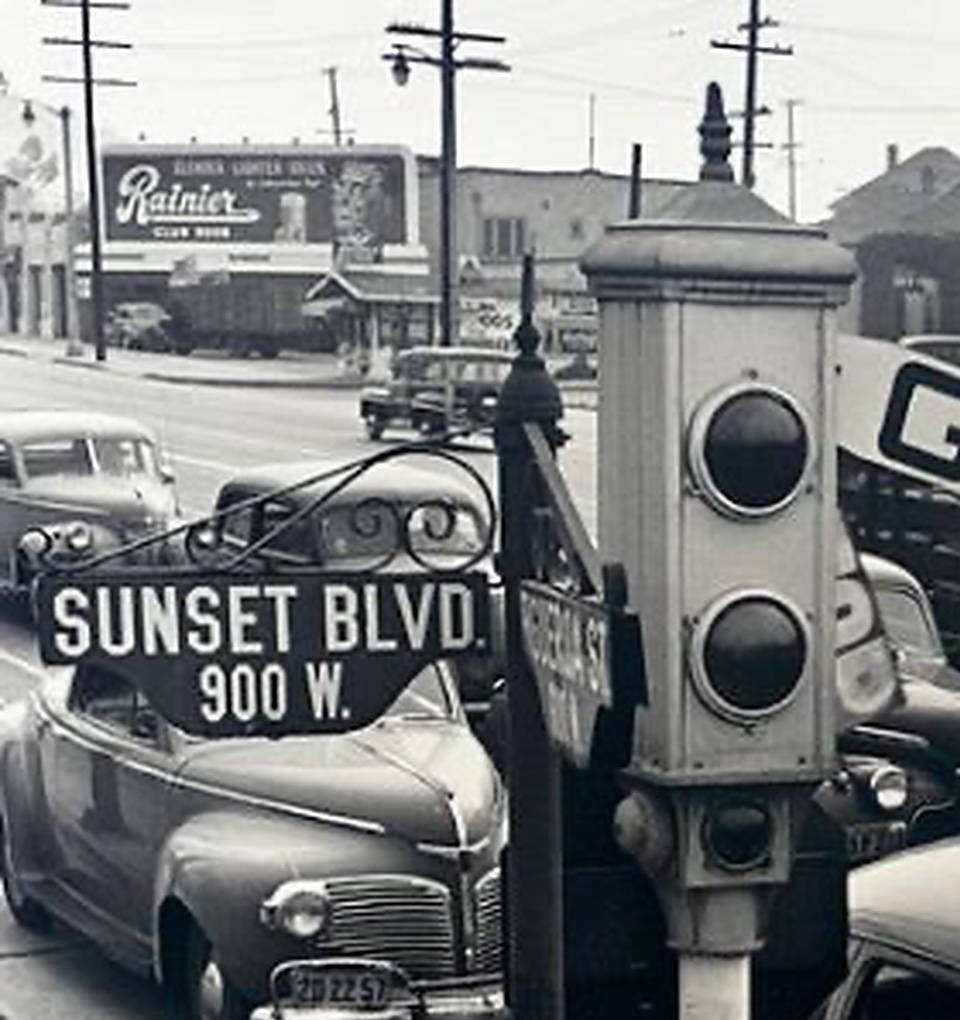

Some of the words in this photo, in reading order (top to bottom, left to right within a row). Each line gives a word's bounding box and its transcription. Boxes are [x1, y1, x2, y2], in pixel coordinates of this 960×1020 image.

[115, 164, 261, 224] Rainier
[53, 585, 297, 657] SUNSET
[324, 583, 487, 652] BLVD.
[199, 663, 289, 722] 900
[306, 663, 352, 721] W.
